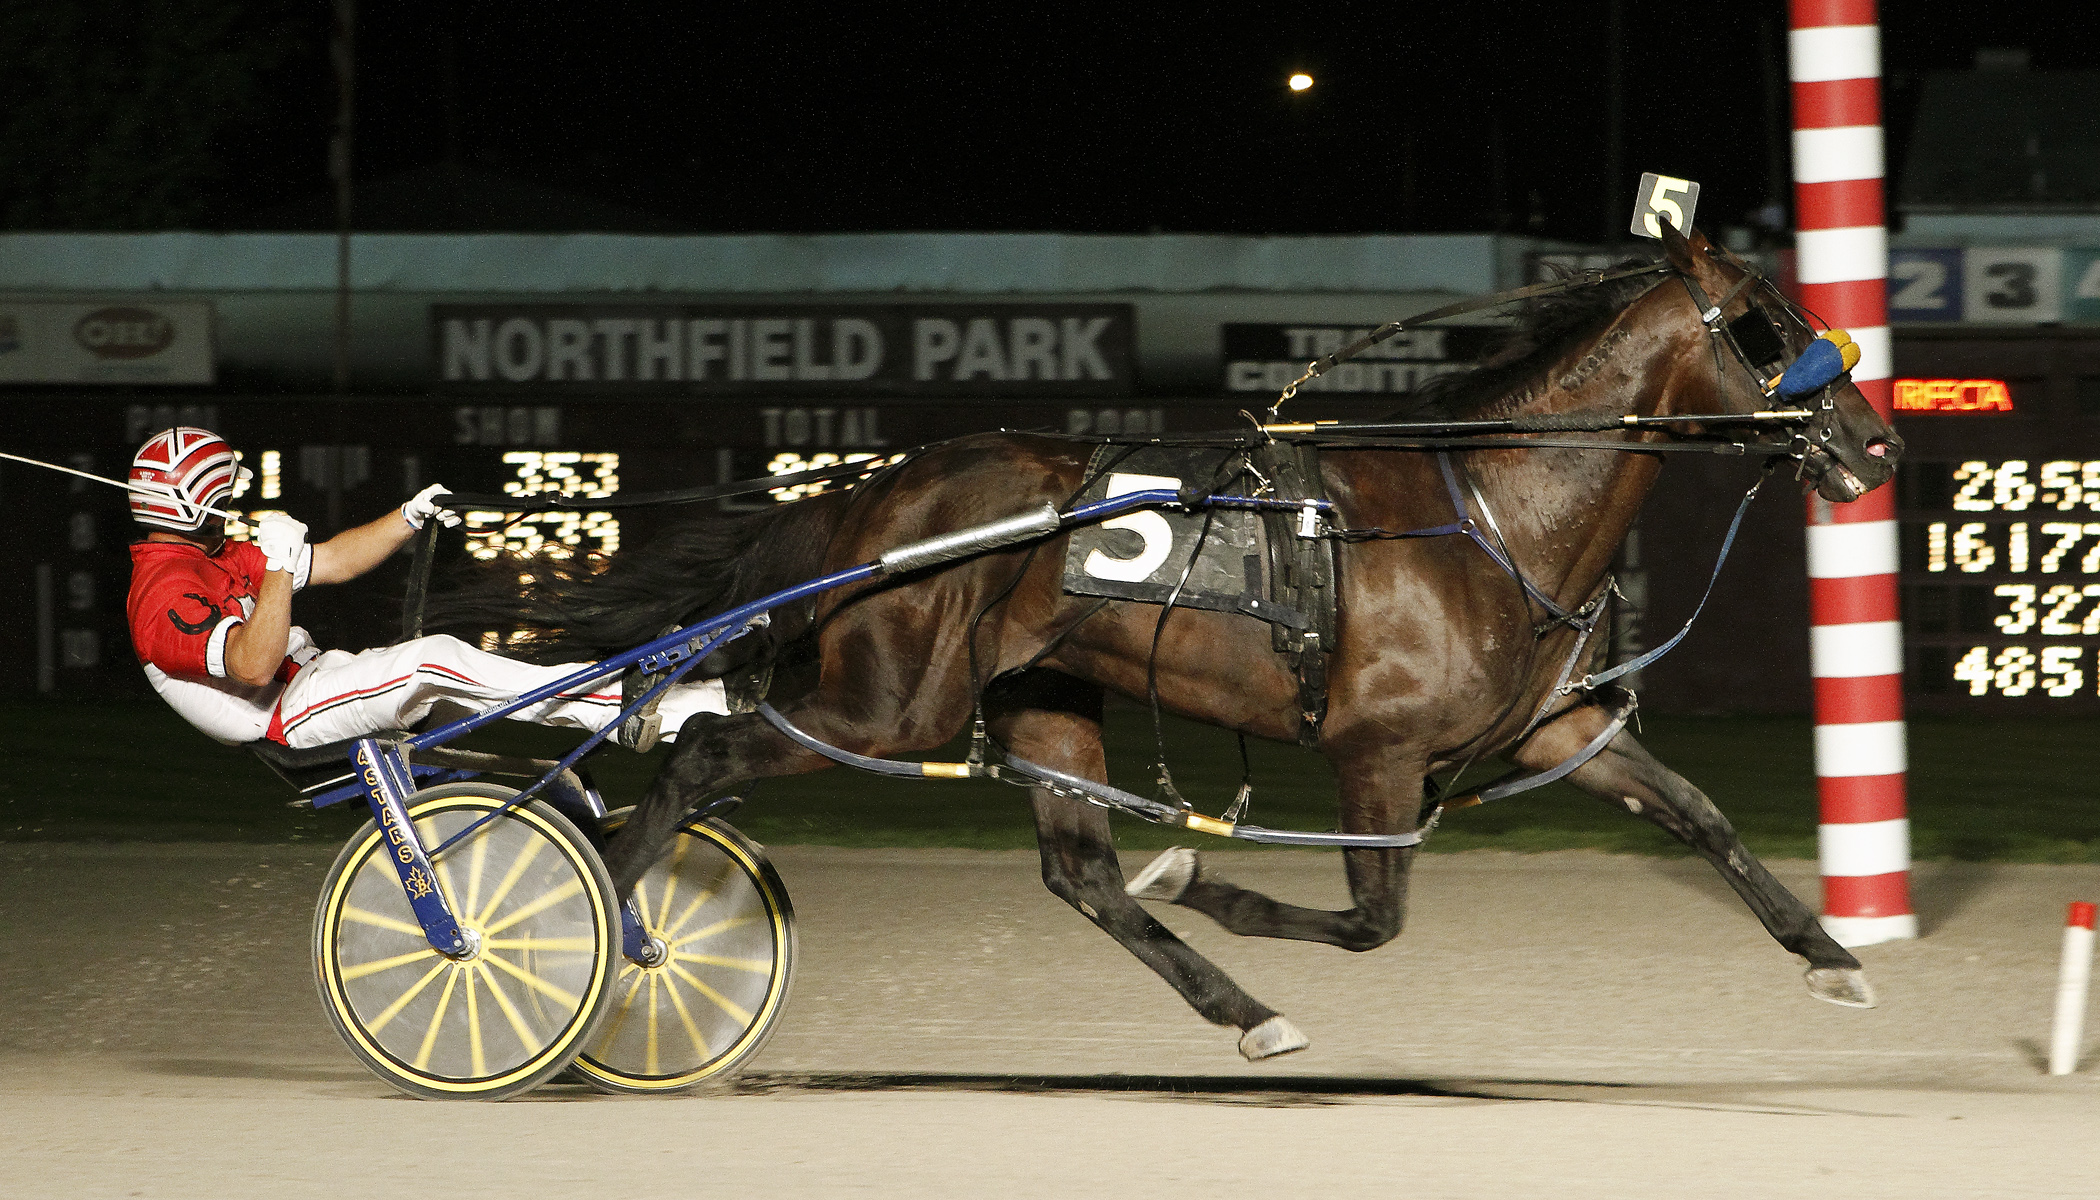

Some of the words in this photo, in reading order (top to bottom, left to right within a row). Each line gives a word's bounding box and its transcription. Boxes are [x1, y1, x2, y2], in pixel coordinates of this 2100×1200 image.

[1643, 175, 1689, 240] 5
[1889, 261, 1947, 309] 2
[1984, 262, 2036, 308] 3
[443, 317, 886, 382] NORTHFIELD
[914, 317, 1118, 382] PARK
[455, 407, 559, 446] SHOW
[761, 408, 889, 447] TOTAL
[502, 451, 620, 499] 353
[1083, 472, 1182, 583] 5
[1953, 645, 2100, 697] 485
